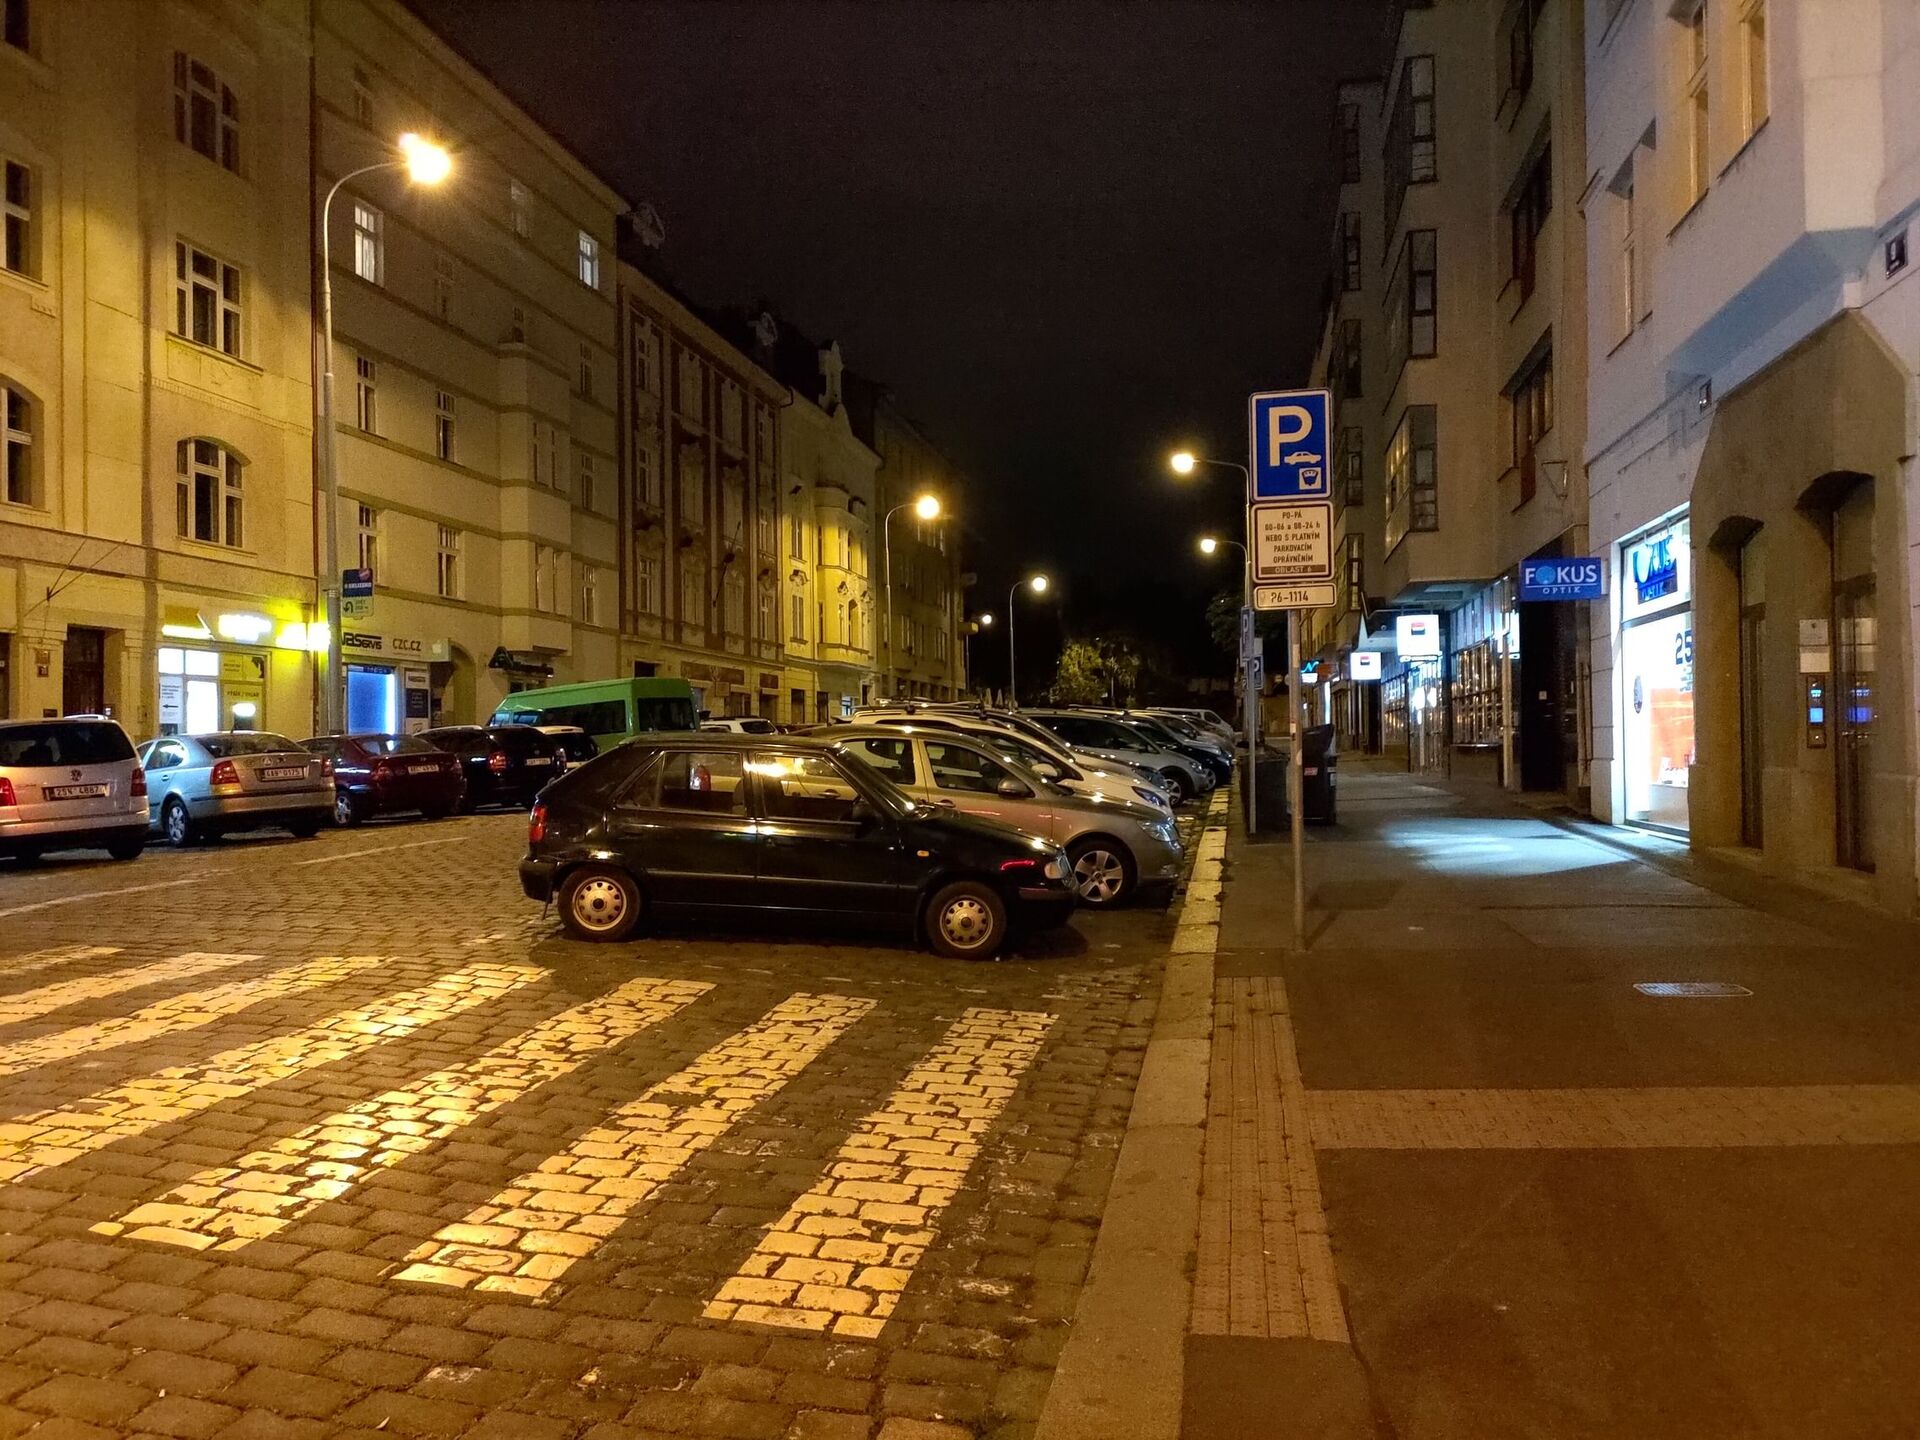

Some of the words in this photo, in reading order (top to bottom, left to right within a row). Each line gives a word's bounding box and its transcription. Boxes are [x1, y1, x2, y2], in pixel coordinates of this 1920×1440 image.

[1269, 405, 1313, 467] P
[1282, 510, 1302, 519] PO-PÁ
[1265, 534, 1282, 542] NEBO
[1291, 531, 1320, 541] PLATNÝM
[1273, 543, 1312, 553] PARKOVACÍM
[1273, 554, 1313, 563] OPRÁVNĚNÍM
[1275, 565, 1303, 573] OBLAST
[1524, 564, 1598, 585] FOKUS
[1542, 585, 1581, 595] OPTIK
[392, 638, 422, 652] CZC.CZ
